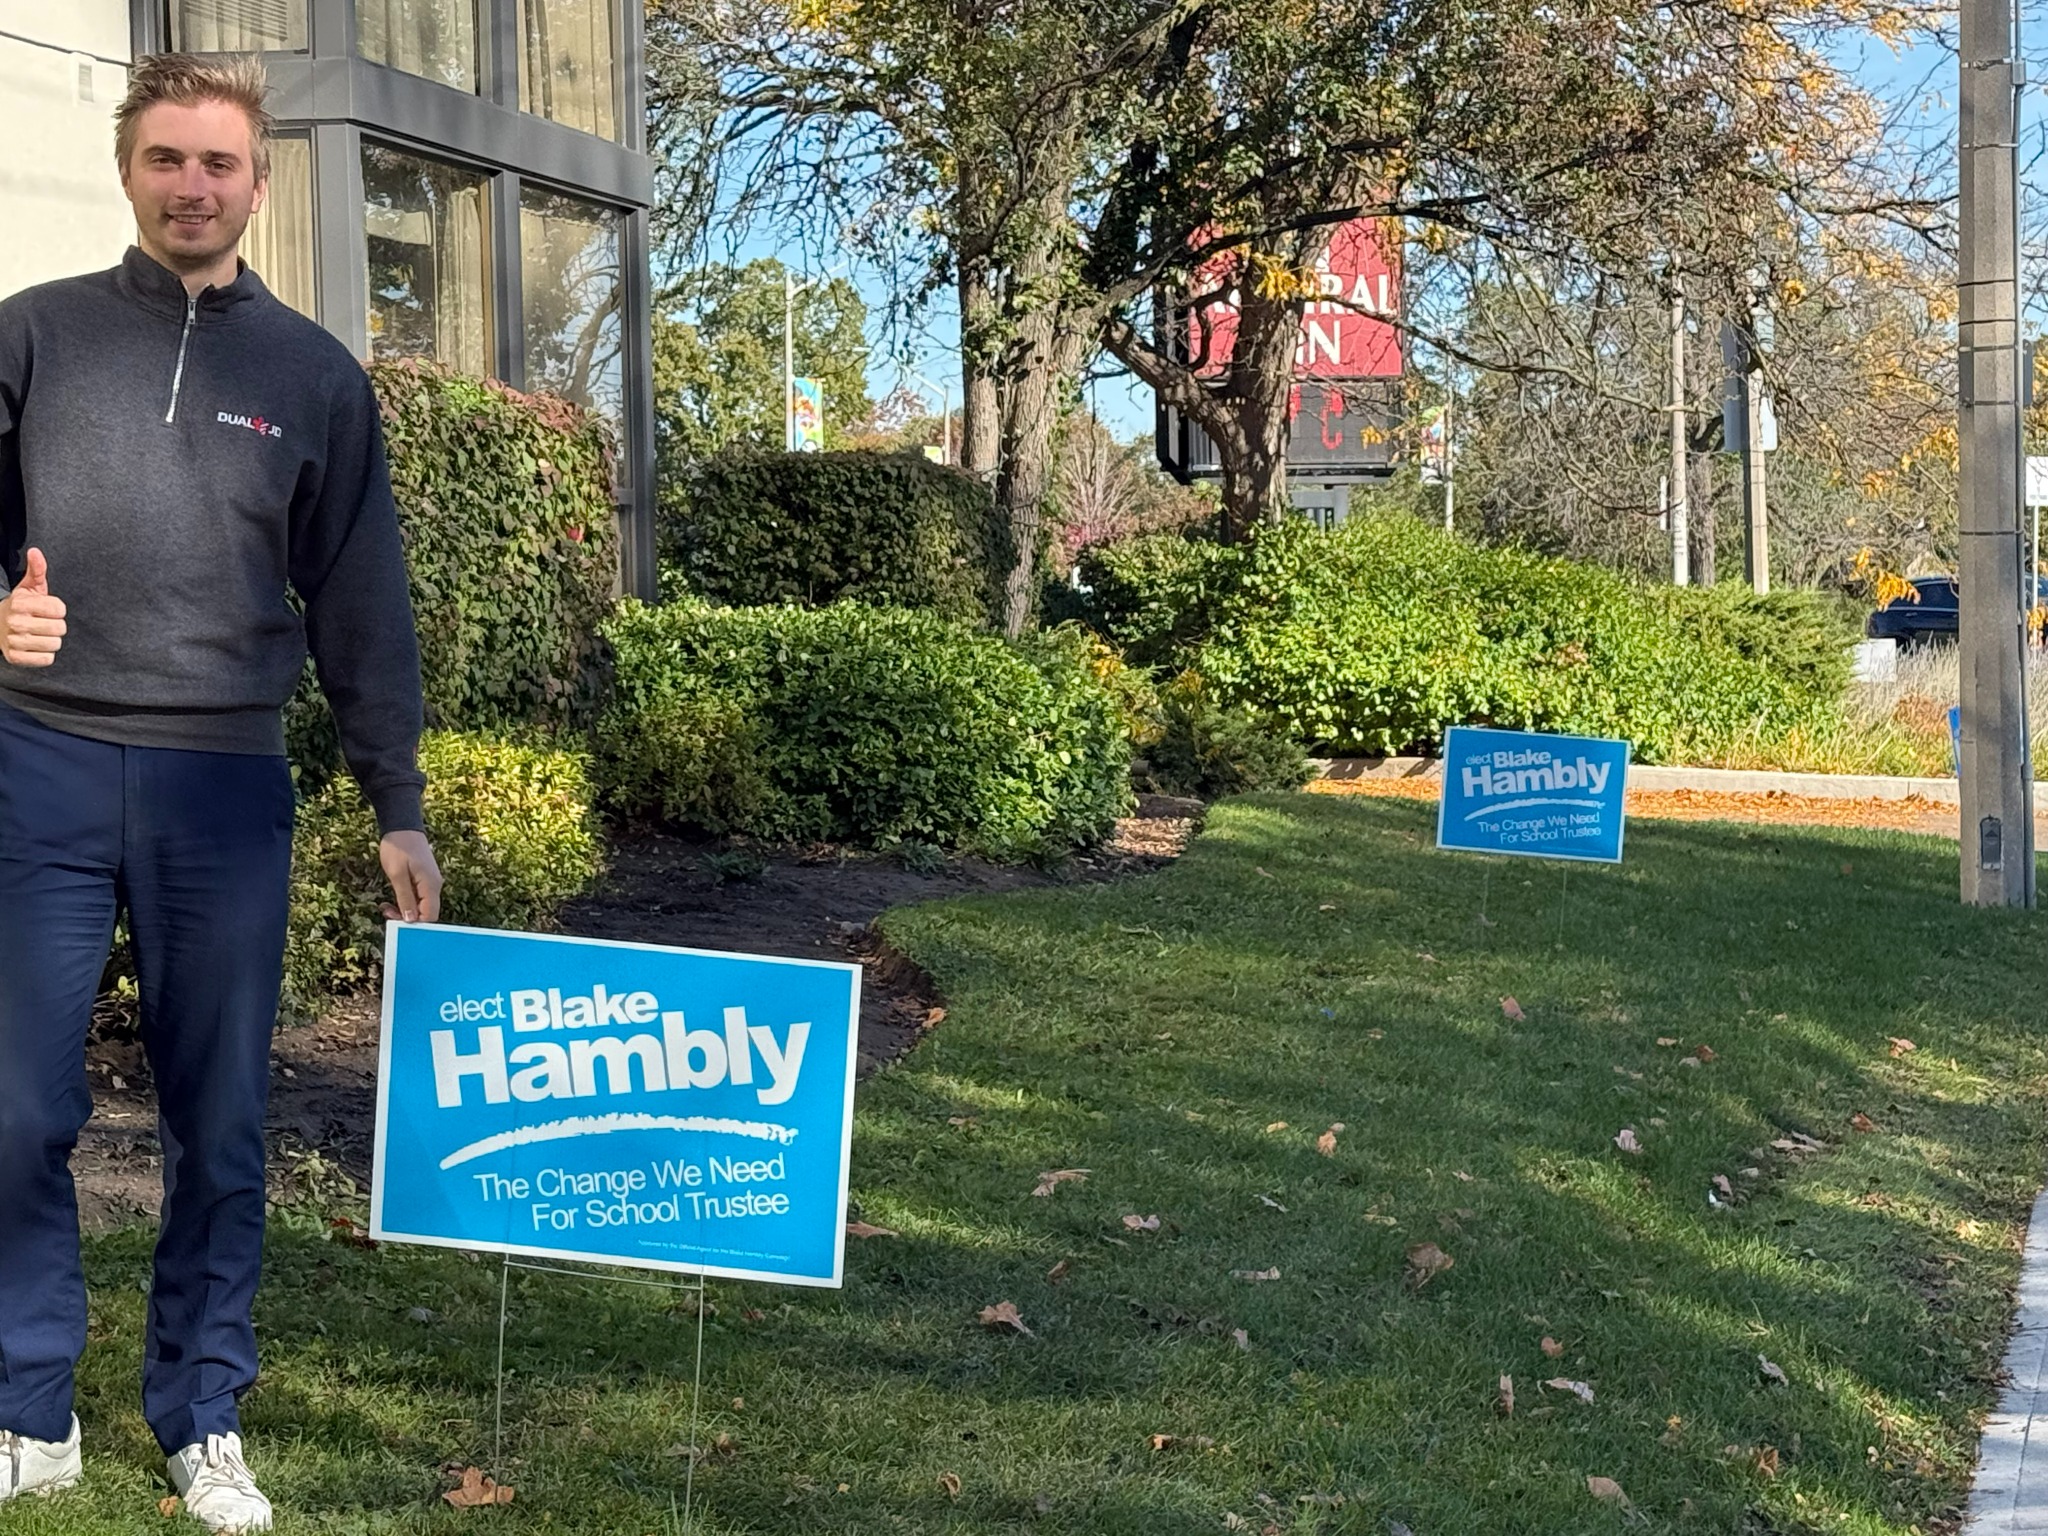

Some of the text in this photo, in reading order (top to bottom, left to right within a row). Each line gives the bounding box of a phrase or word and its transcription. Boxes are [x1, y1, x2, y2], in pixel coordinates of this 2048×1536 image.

[217, 411, 255, 430] DUAL
[1461, 756, 1611, 798] Hambly
[1465, 748, 1551, 769] elect Blake
[1477, 811, 1600, 833] The Change We Need
[1500, 826, 1602, 845] For School Trustee
[439, 983, 659, 1034] elect Blake
[429, 1006, 812, 1109] Hambly
[472, 1151, 786, 1202] The Change We Need
[531, 1189, 790, 1232] For School Trustee
